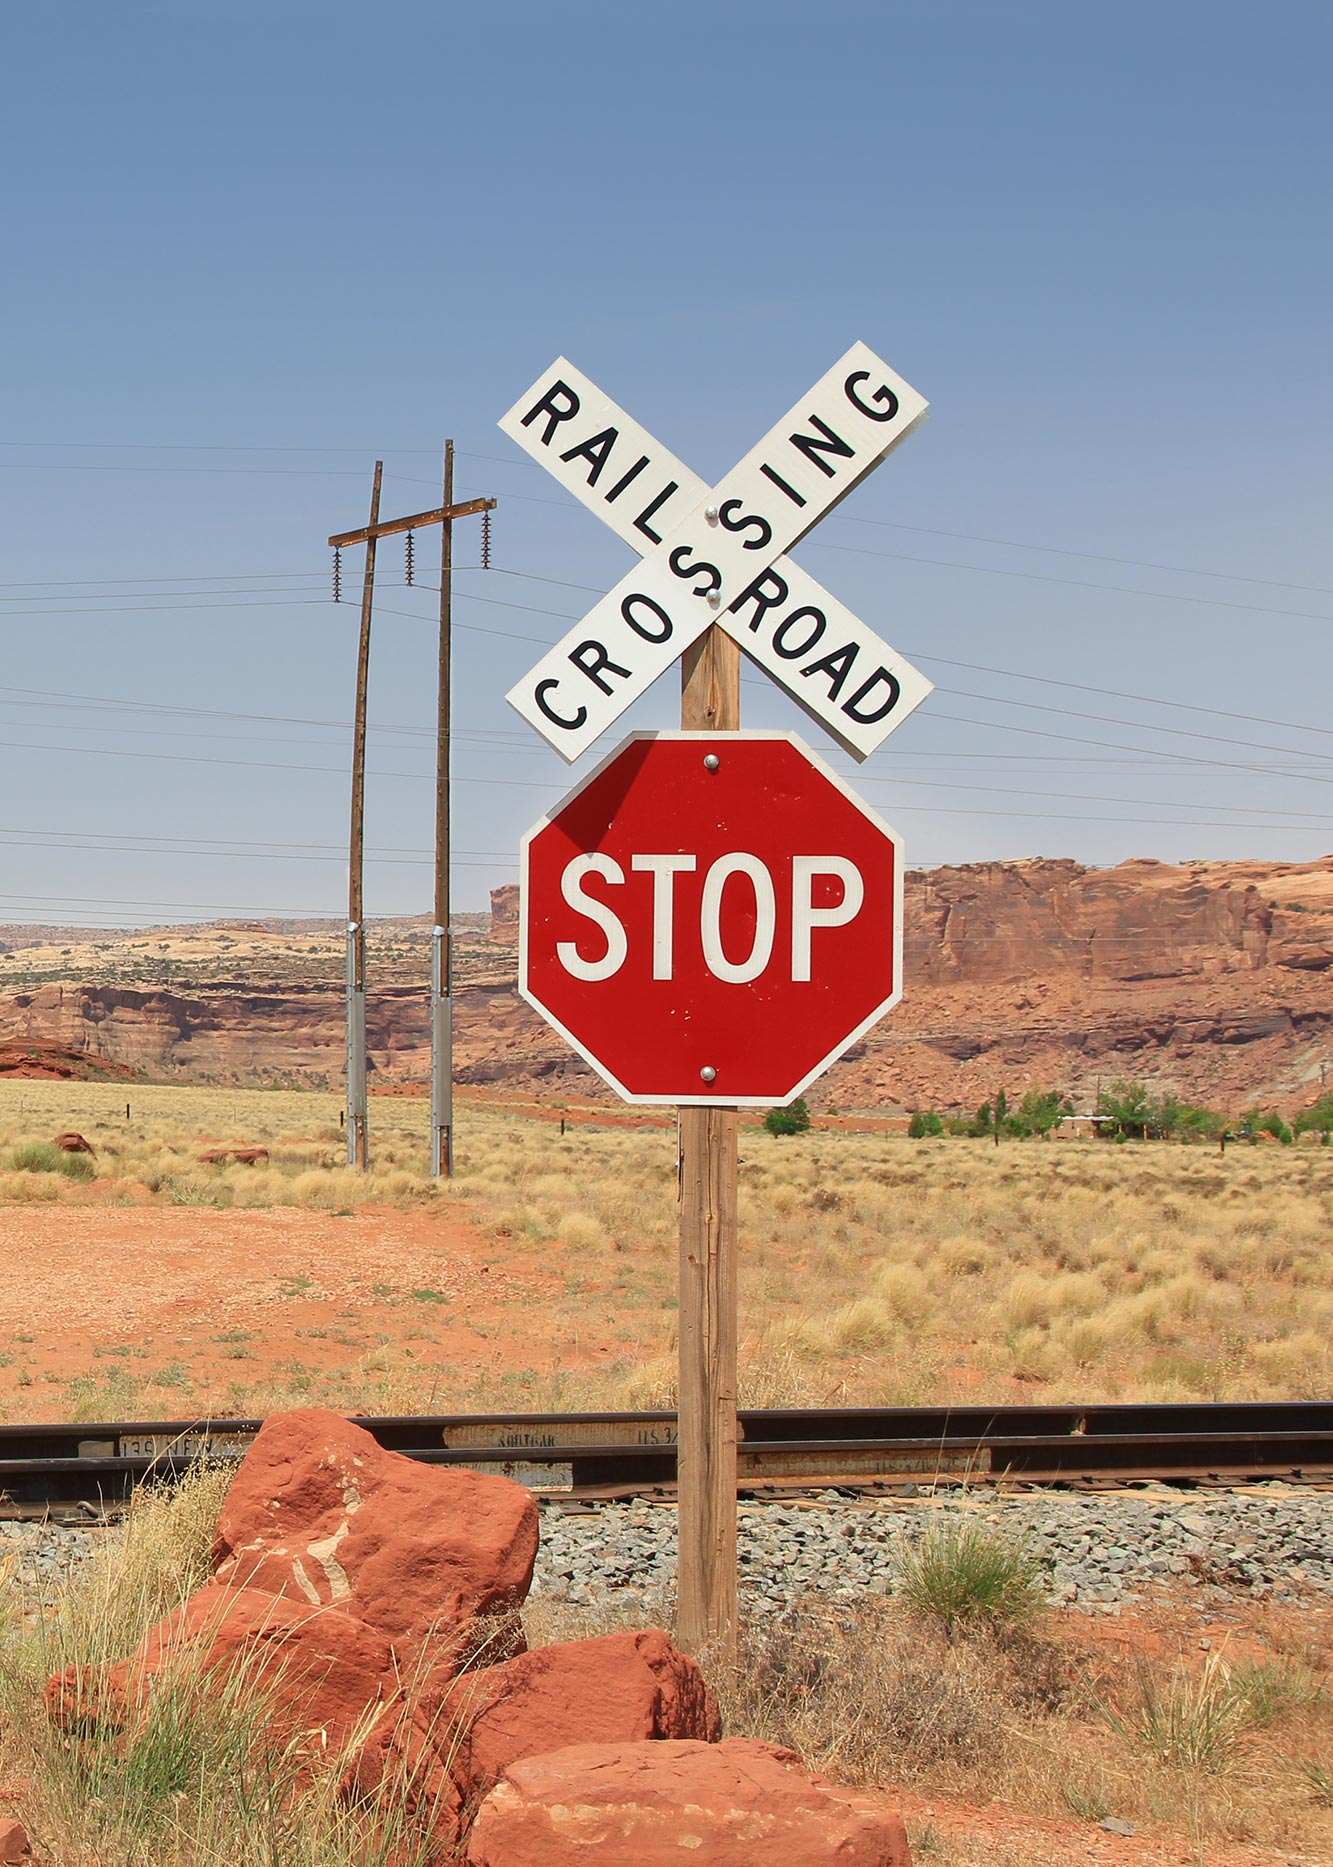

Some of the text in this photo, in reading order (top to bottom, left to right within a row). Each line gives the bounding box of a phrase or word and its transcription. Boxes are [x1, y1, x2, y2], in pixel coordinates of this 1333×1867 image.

[520, 379, 901, 725] RAIL ROAD
[534, 370, 899, 730] CROSSING
[556, 852, 864, 984] STOP
